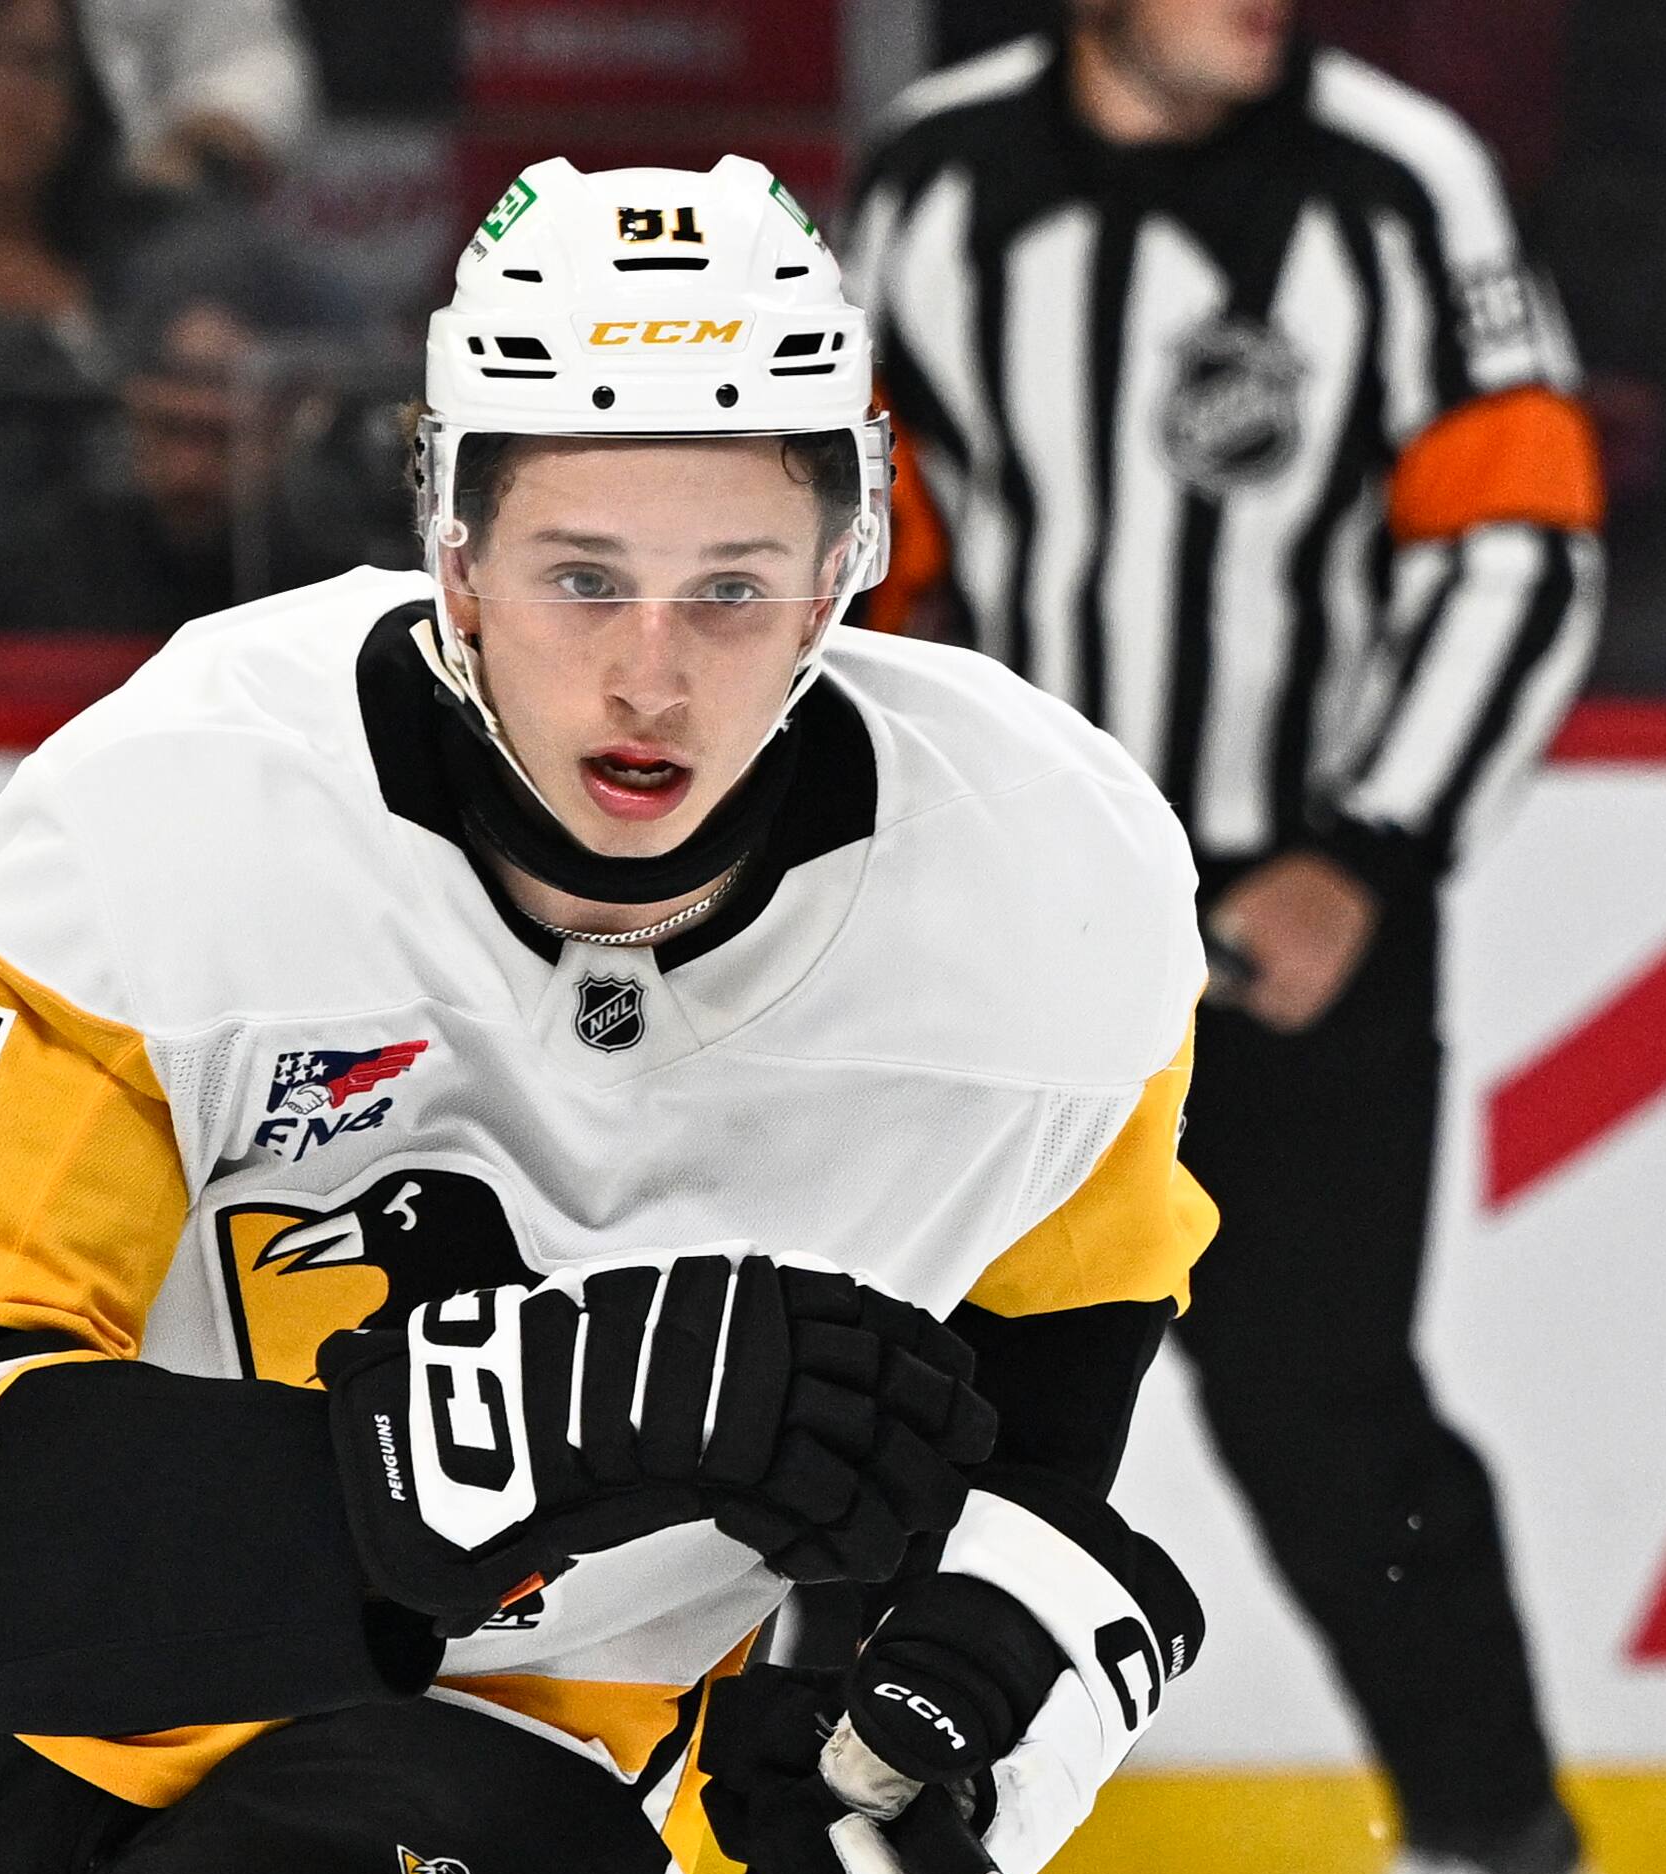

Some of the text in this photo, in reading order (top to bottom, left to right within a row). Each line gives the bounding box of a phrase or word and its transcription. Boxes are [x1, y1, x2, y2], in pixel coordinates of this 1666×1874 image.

[587, 320, 744, 346] CCM
[589, 996, 633, 1036] NHL
[374, 1414, 407, 1502] PENGUINS
[873, 1682, 966, 1750] CCM
